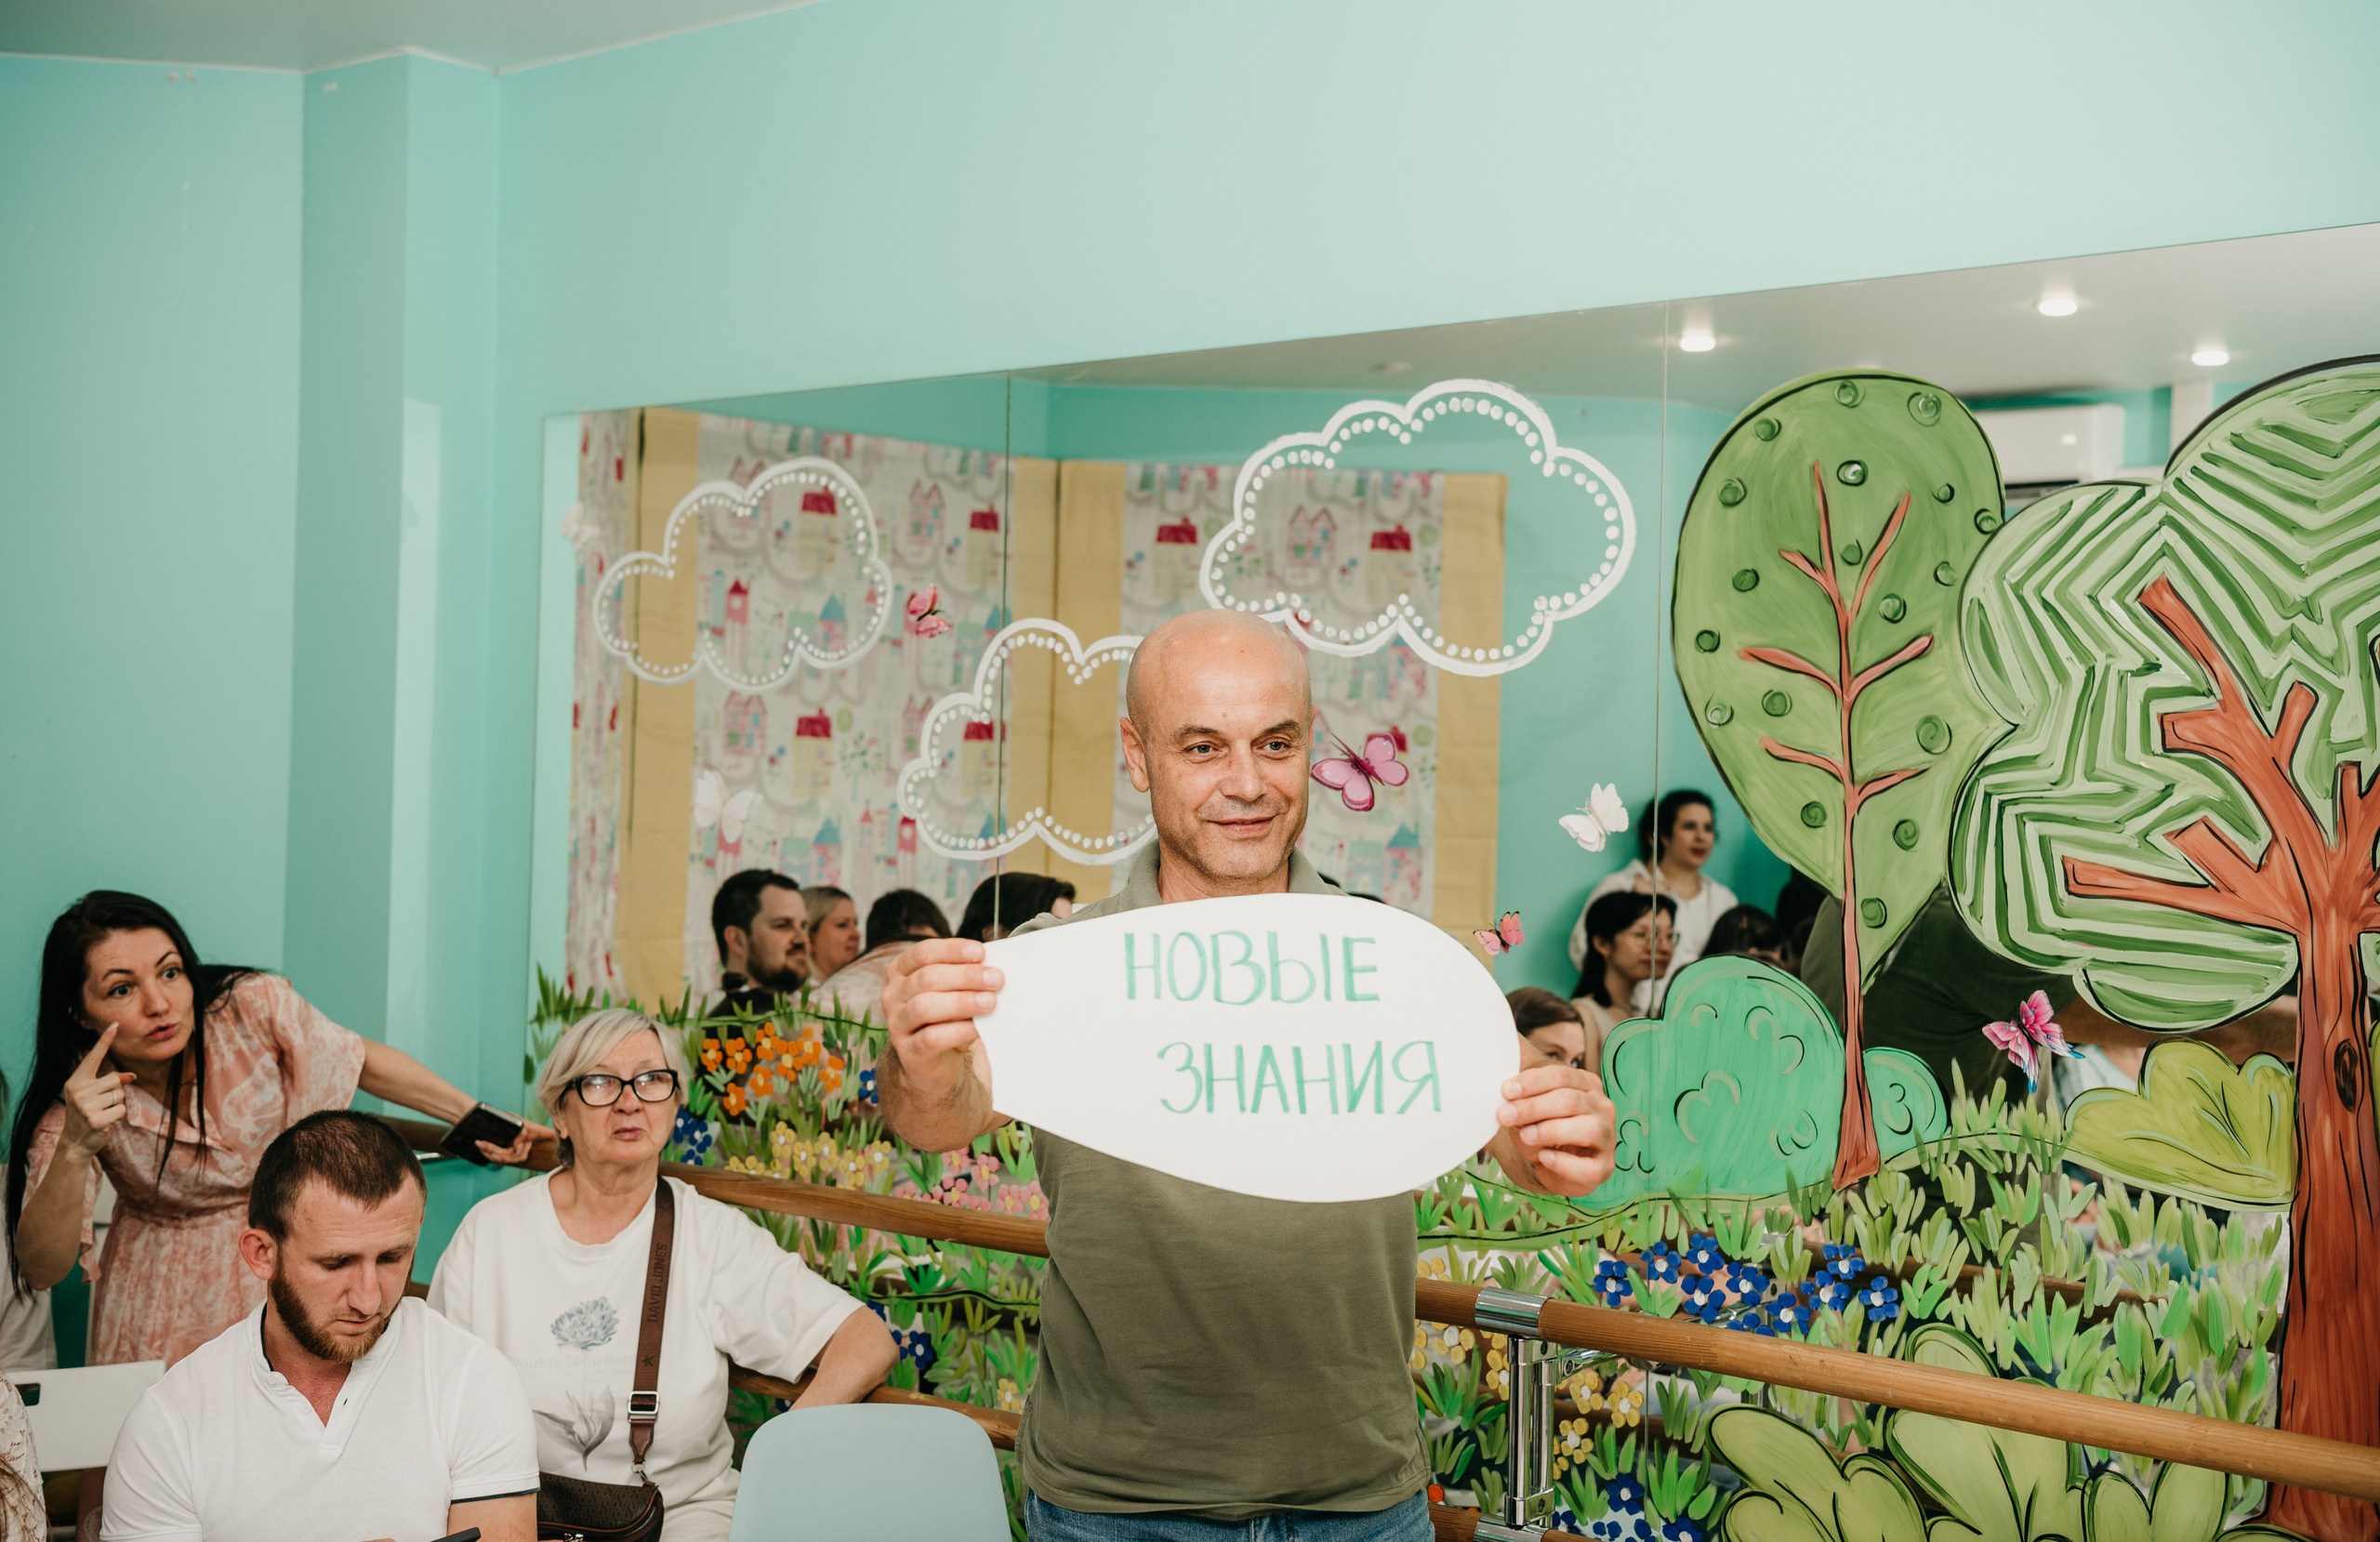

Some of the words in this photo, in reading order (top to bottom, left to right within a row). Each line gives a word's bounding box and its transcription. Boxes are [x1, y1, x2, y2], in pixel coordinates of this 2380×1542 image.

[1123, 930, 1381, 1006] НОВЫЕ
[1157, 1040, 1442, 1115] ЗНАНИЯ
[653, 1243, 667, 1282] JONES
[647, 1285, 662, 1322] DAVID
